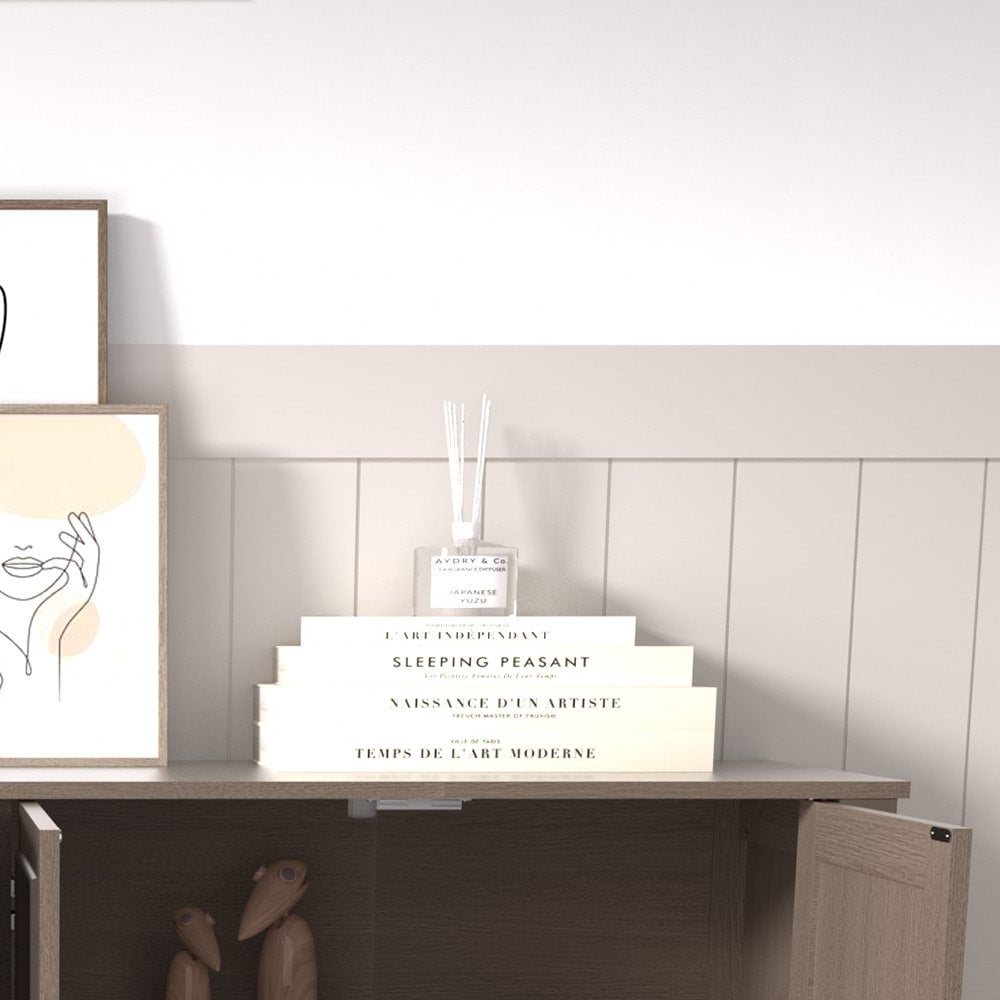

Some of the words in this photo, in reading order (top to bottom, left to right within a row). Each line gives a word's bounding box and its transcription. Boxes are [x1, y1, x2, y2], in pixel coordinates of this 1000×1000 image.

[385, 630, 431, 641] L'ART
[392, 656, 489, 668] SLEEPING
[501, 656, 590, 668] PEASANT
[390, 697, 490, 709] NAISSANCE
[497, 697, 540, 709] D'UN
[547, 697, 622, 709] ARTISTE
[354, 747, 412, 760] TEMPS
[419, 747, 444, 760] DE
[451, 747, 502, 760] L'ART
[510, 747, 596, 760] MODERNE
